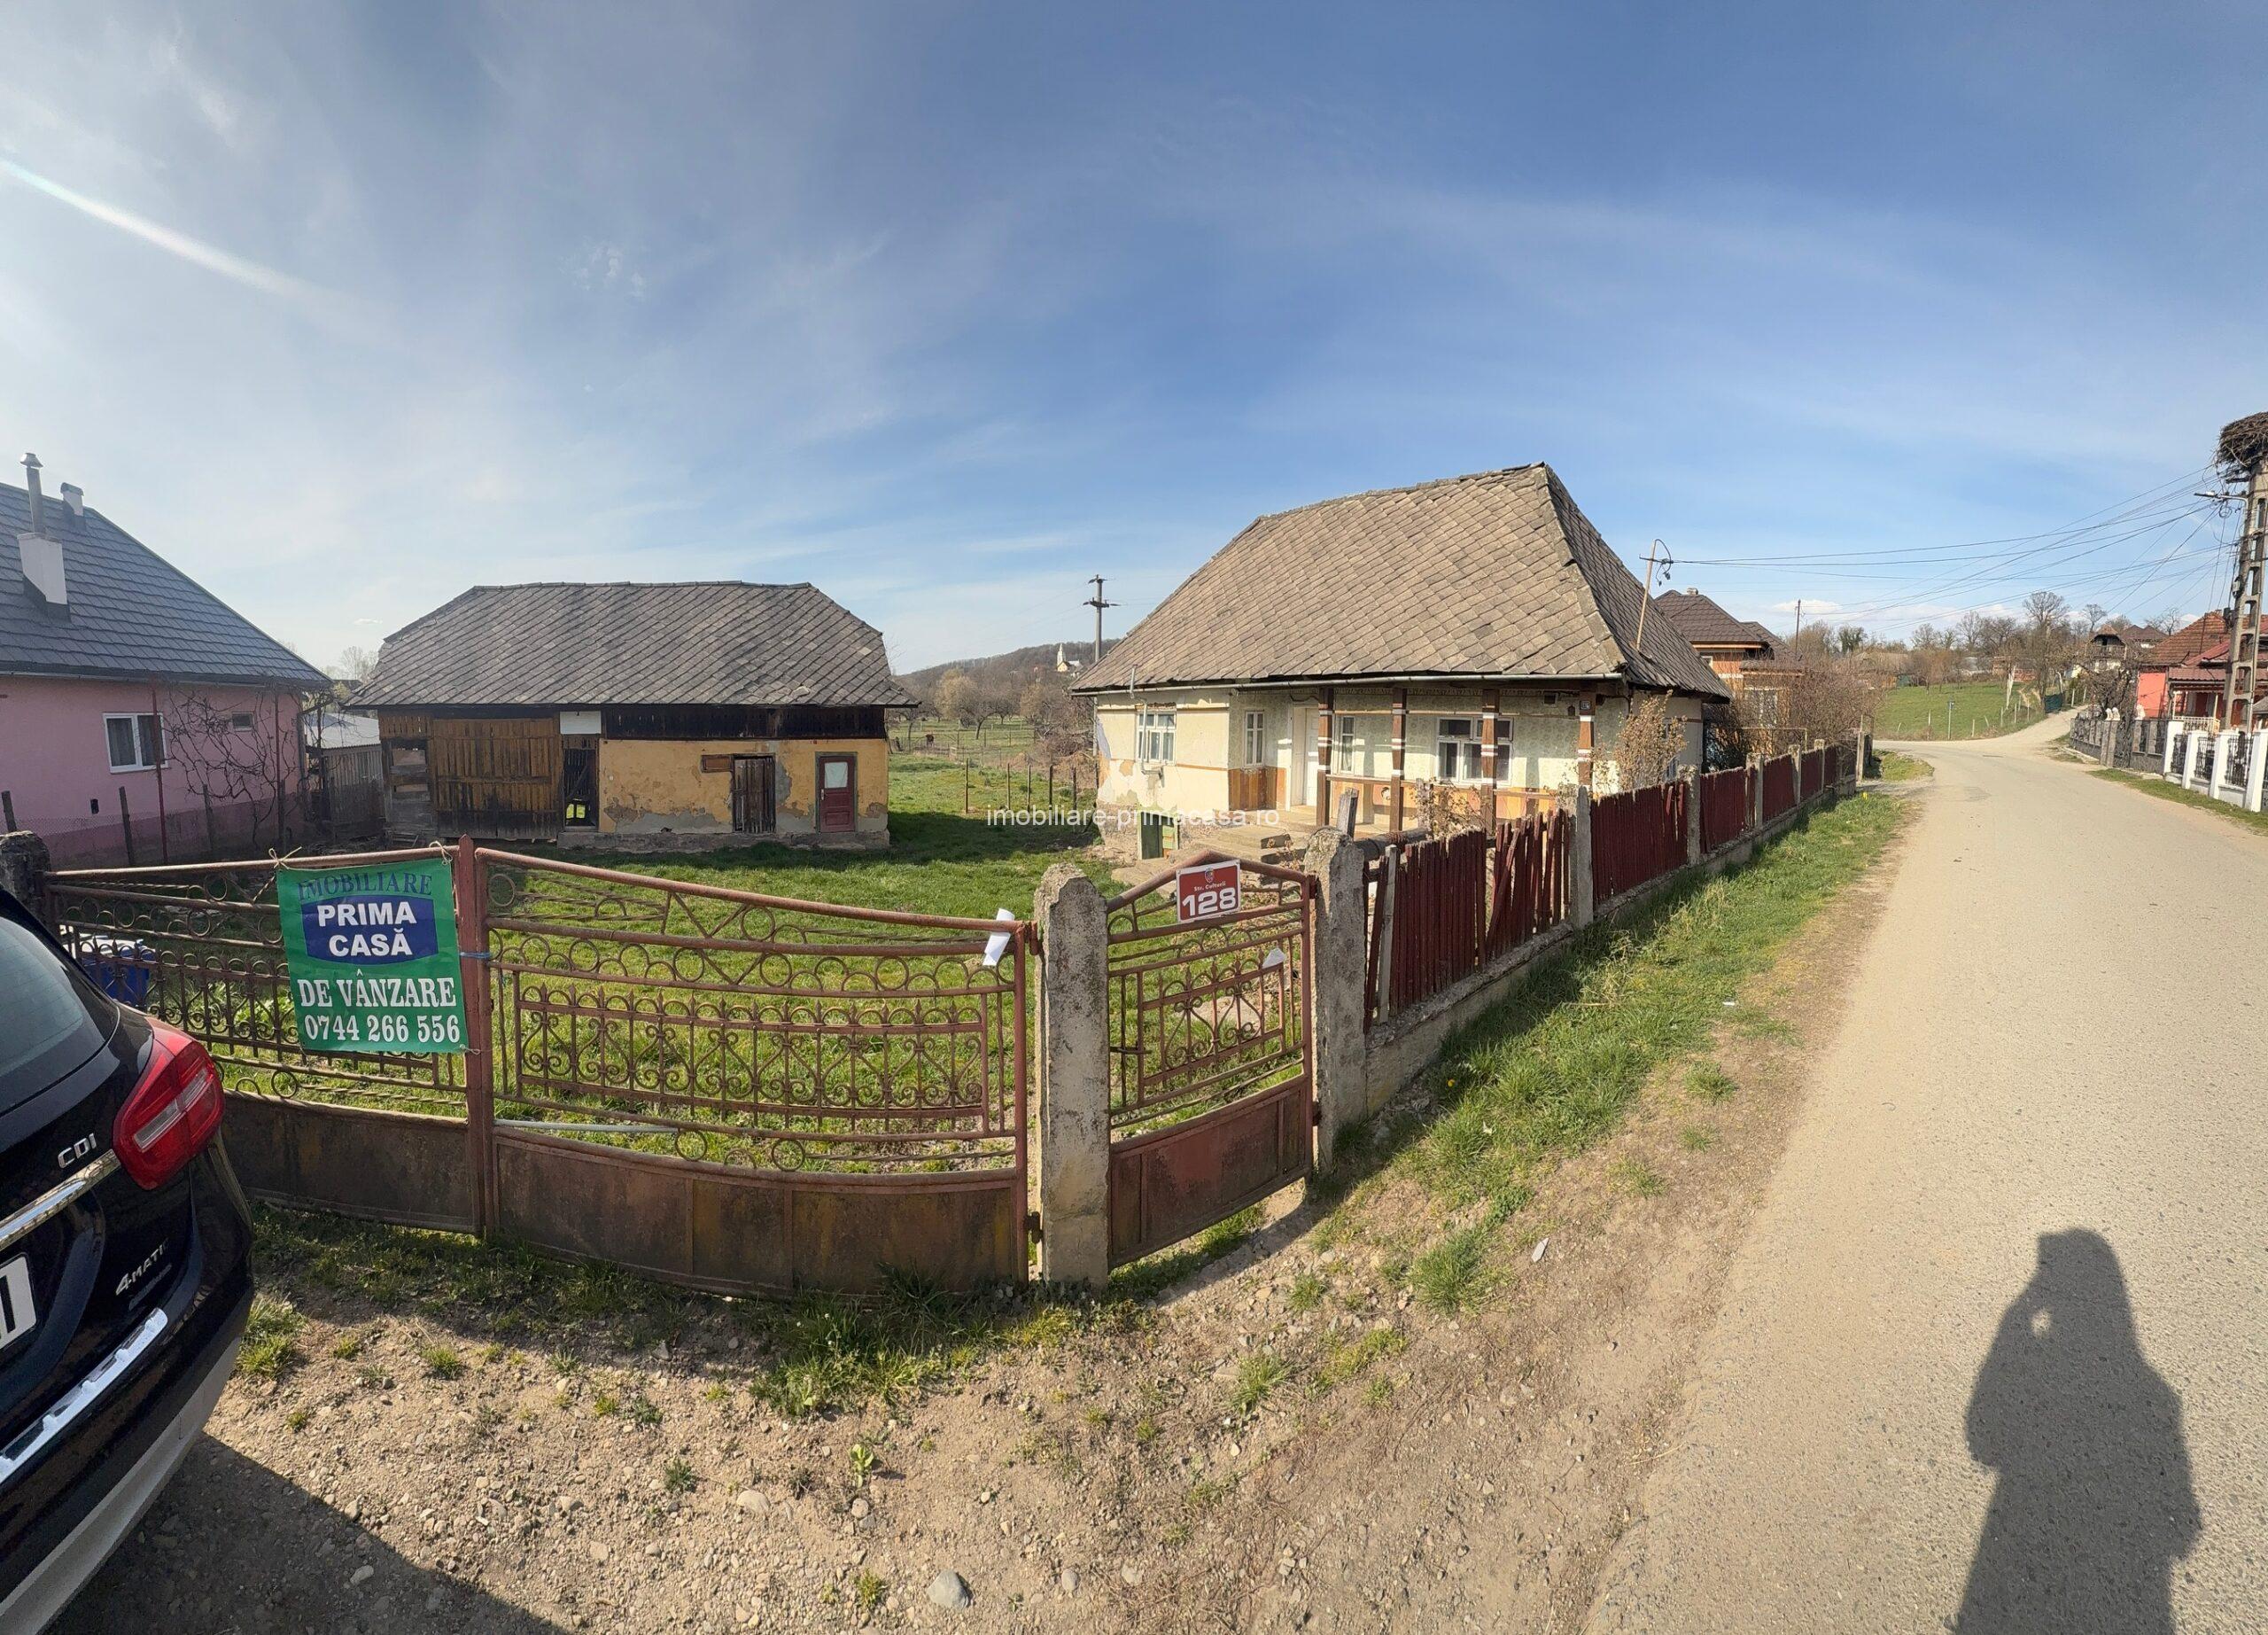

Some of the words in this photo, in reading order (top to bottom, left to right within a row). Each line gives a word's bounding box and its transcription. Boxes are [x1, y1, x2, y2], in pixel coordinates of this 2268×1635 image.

[298, 871, 432, 900] IMOBILIARE
[317, 901, 416, 927] PRIMA
[1182, 887, 1236, 916] 128
[329, 928, 412, 957] CASĂ
[297, 978, 332, 1008] DE
[336, 968, 457, 1008] VÂNZARE
[304, 1015, 360, 1041] 0744
[367, 1015, 409, 1042] 266
[417, 1015, 460, 1043] 556
[58, 1133, 97, 1169] CDI
